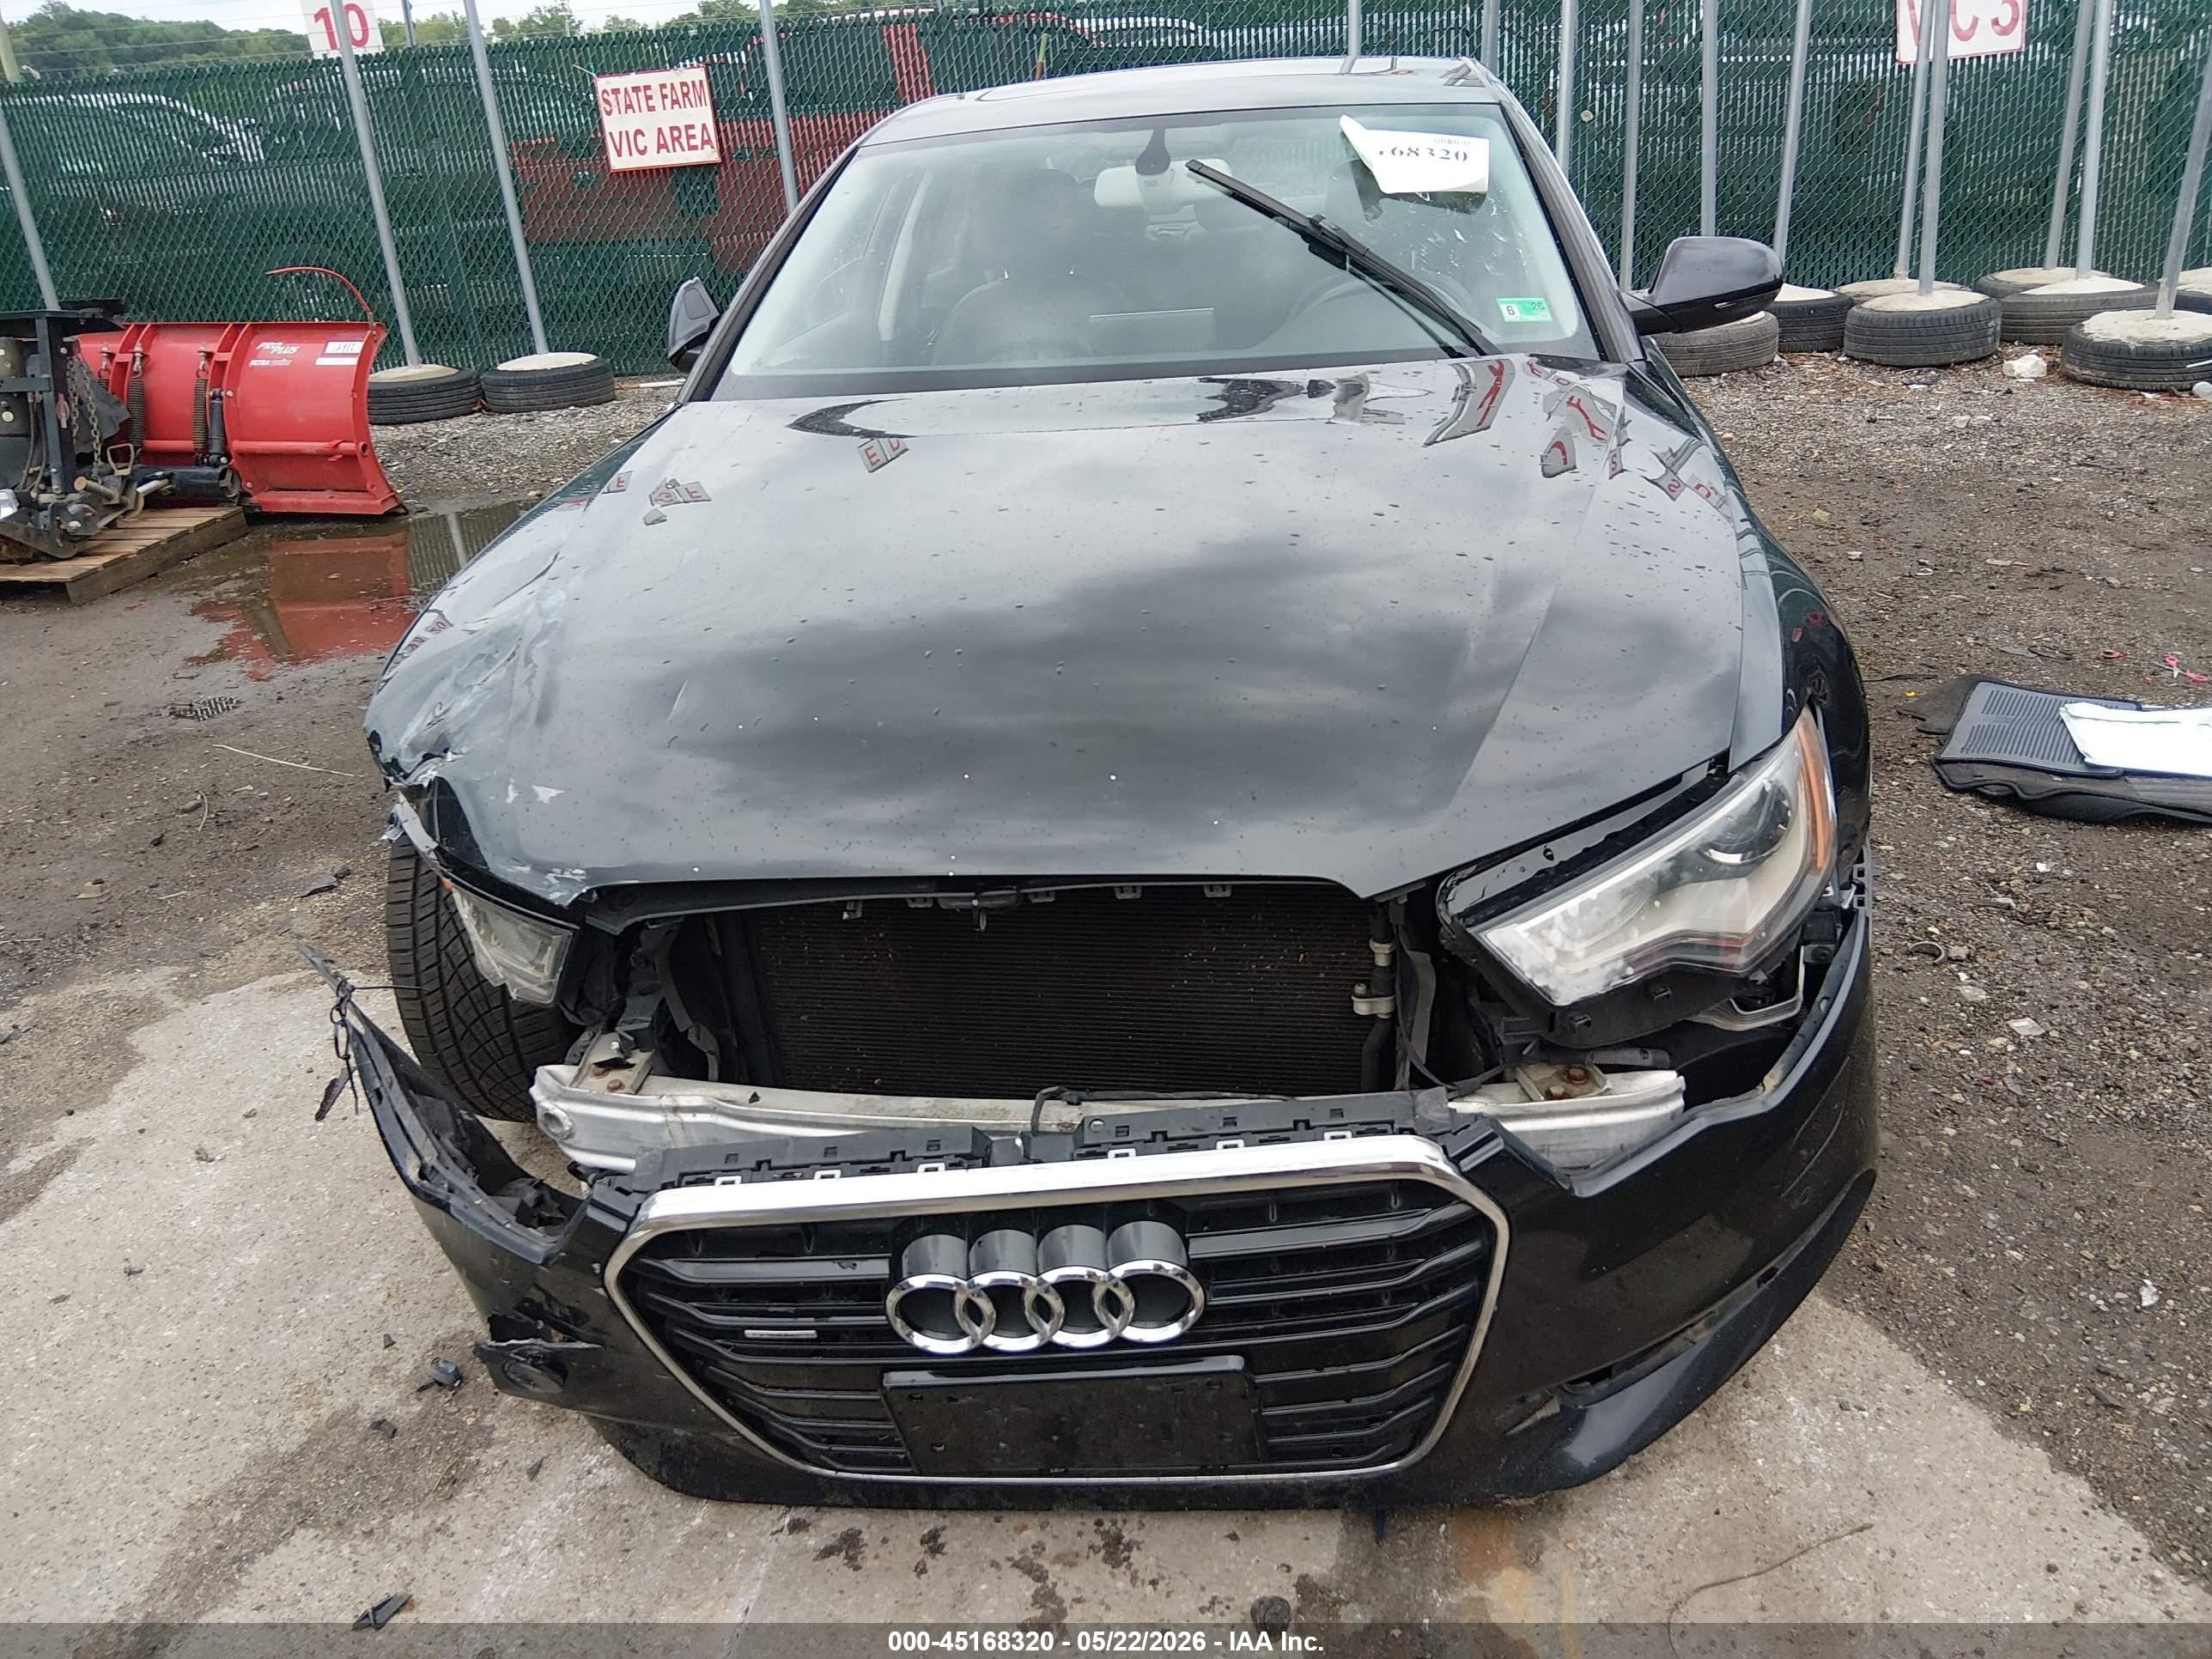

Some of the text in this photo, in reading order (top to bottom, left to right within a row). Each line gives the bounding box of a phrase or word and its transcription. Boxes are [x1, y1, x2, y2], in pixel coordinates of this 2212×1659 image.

[314, 3, 368, 50] 10
[601, 79, 708, 116] STATE FARM
[609, 123, 715, 158] VIC AREA
[1505, 305, 1516, 316] 6
